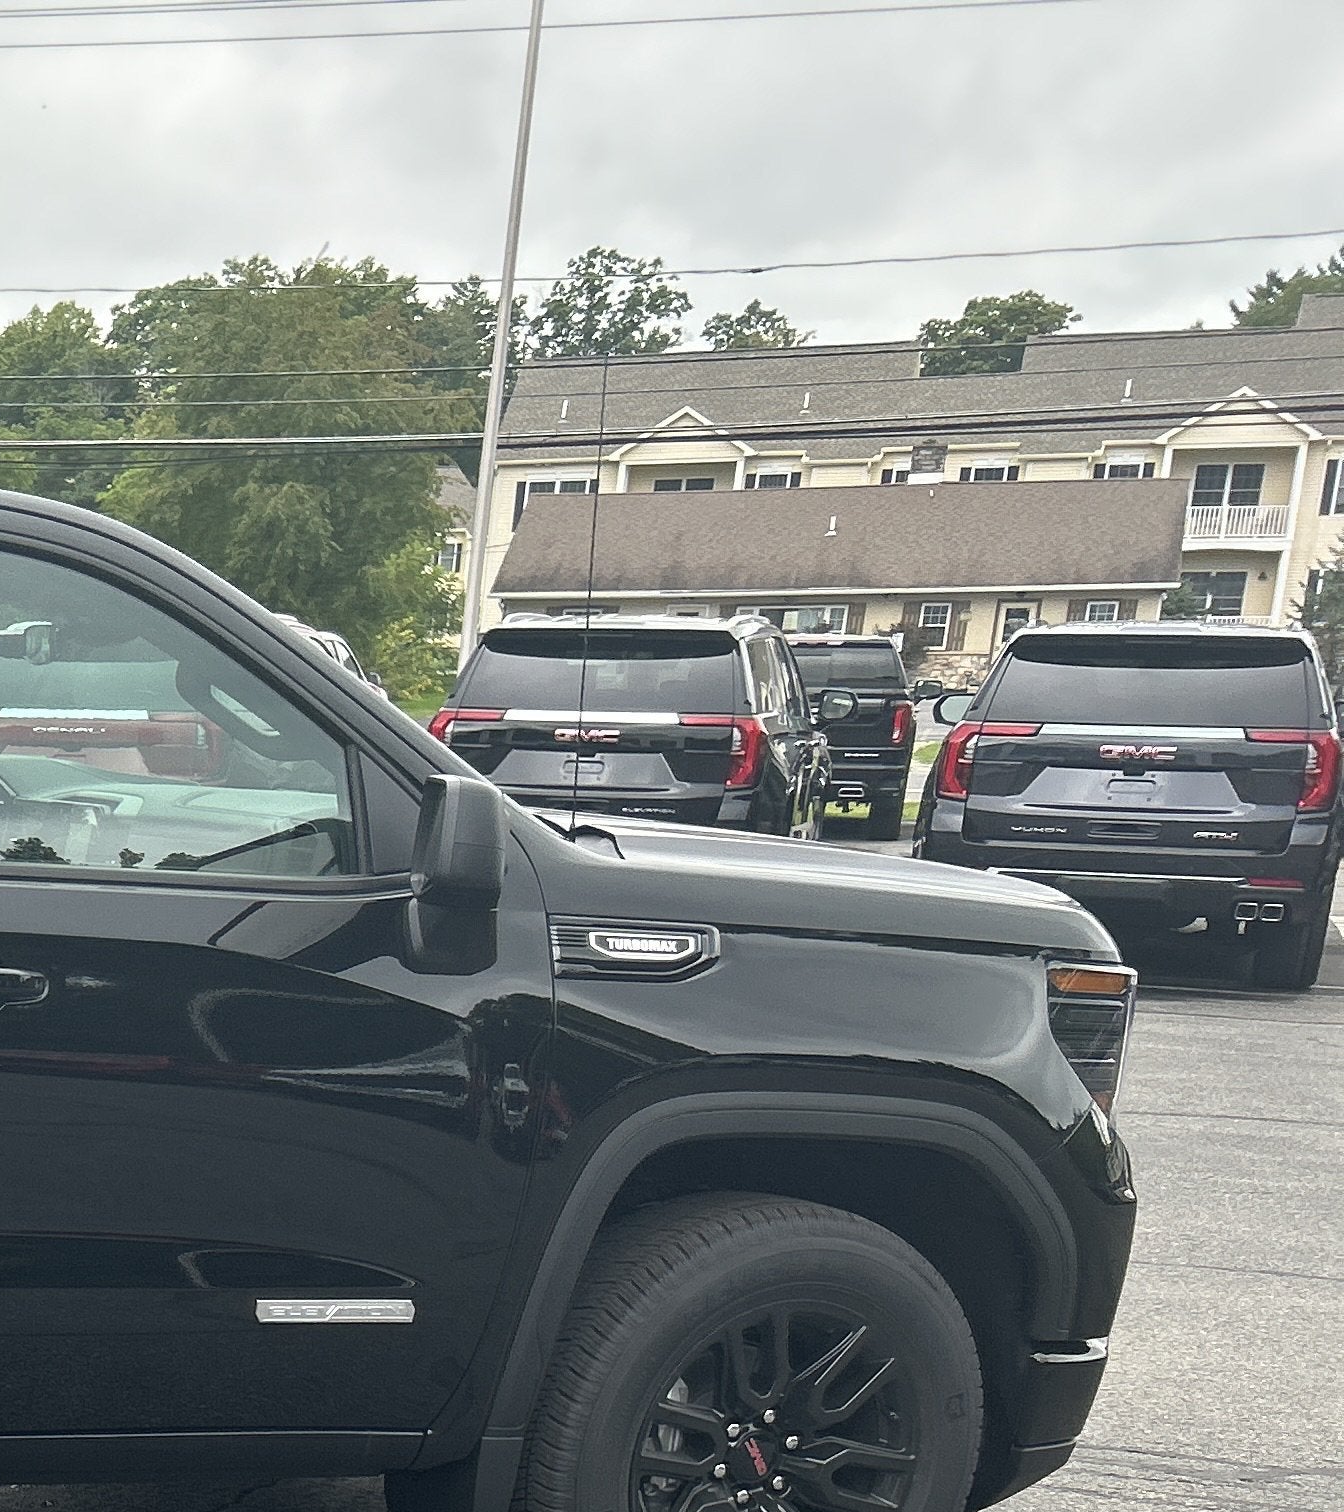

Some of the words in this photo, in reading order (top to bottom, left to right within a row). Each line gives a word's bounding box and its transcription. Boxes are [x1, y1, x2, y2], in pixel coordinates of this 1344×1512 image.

[554, 728, 621, 744] GMC
[1099, 744, 1178, 761] GMC
[606, 937, 678, 953] TURBOMAX
